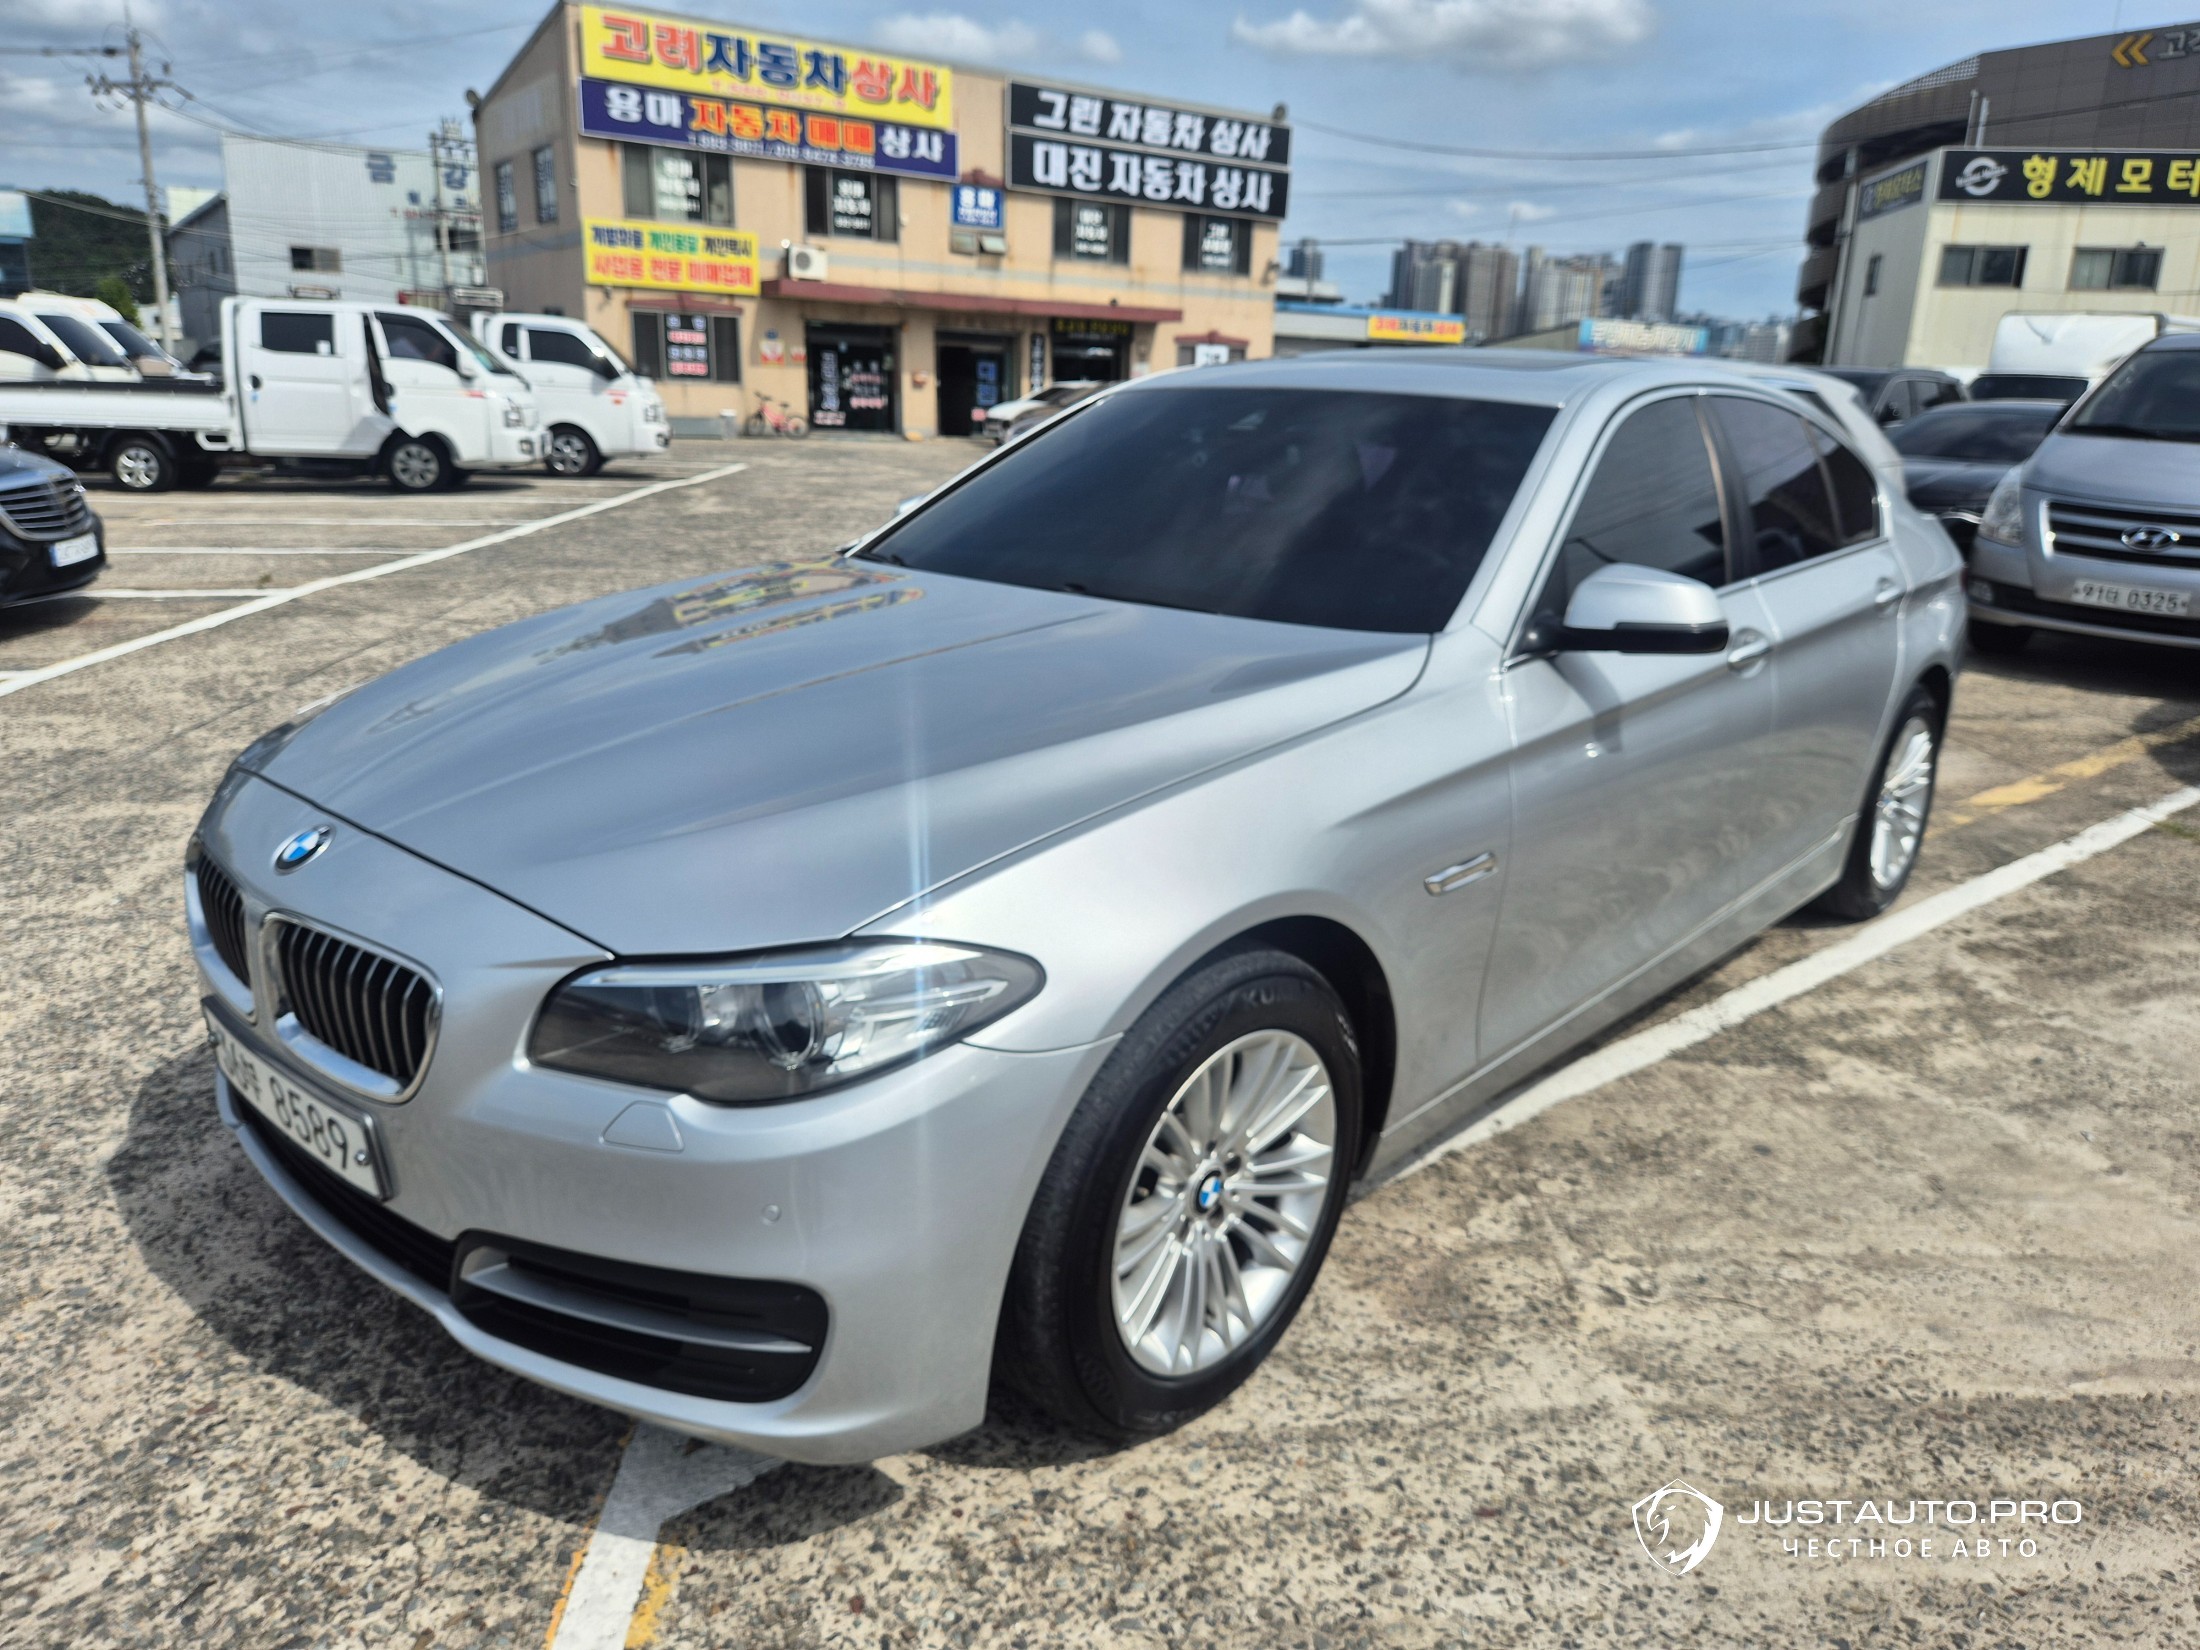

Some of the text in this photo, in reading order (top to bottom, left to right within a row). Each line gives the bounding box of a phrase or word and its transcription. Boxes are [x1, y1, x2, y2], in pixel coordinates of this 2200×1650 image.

[604, 85, 684, 129] 용마
[880, 125, 944, 164] 상사
[1033, 89, 1272, 161] 그린 자동차 상사
[1033, 141, 1274, 213] 대진 자동차 상사
[2127, 589, 2180, 613] 0325
[269, 1075, 348, 1169] 8589
